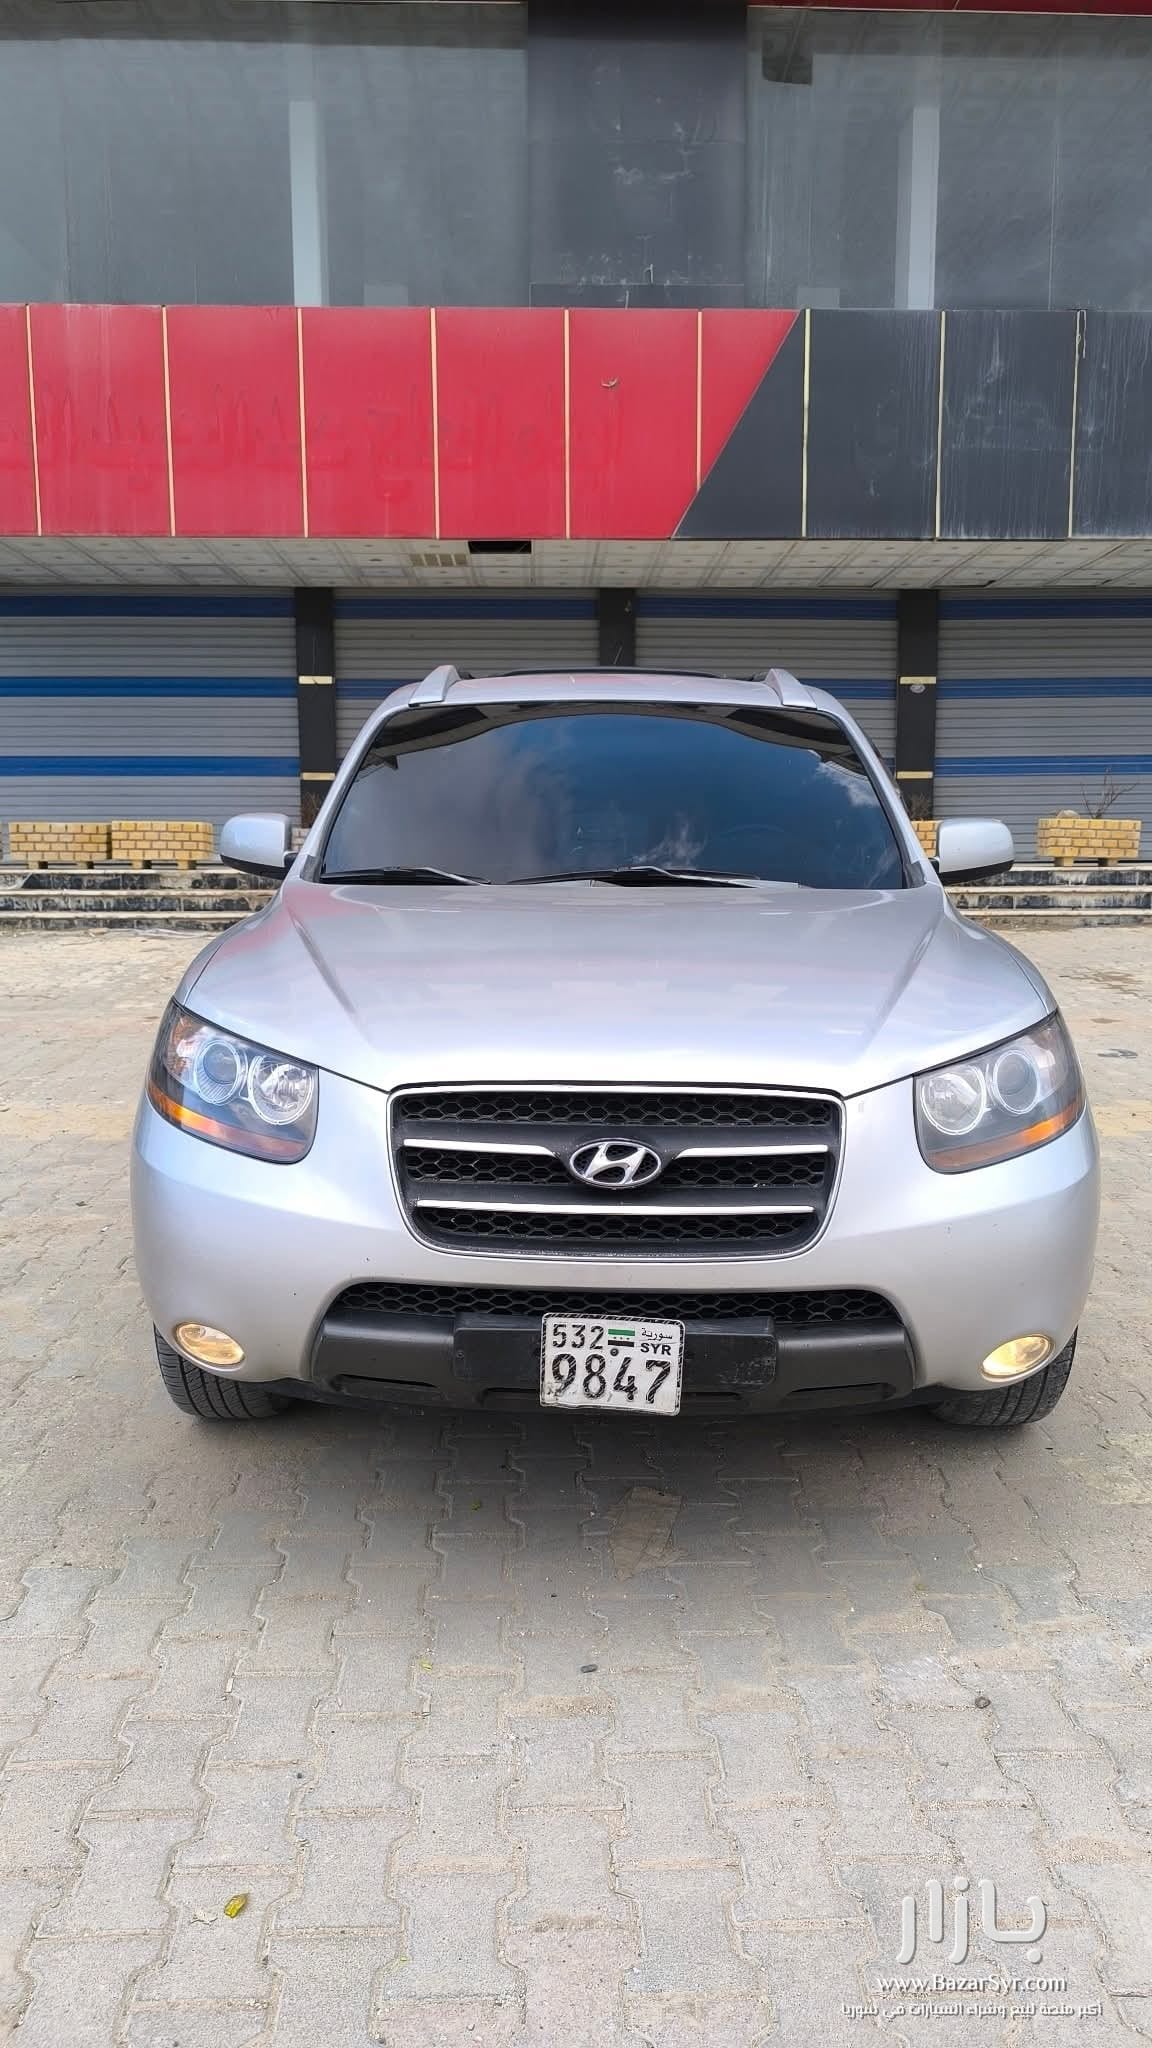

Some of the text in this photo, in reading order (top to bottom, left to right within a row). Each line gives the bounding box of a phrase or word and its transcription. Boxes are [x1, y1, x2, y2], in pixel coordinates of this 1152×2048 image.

[552, 1323, 605, 1350] 532
[641, 1327, 673, 1342] سورية
[640, 1342, 672, 1356] SYR
[552, 1353, 671, 1404] 9847
